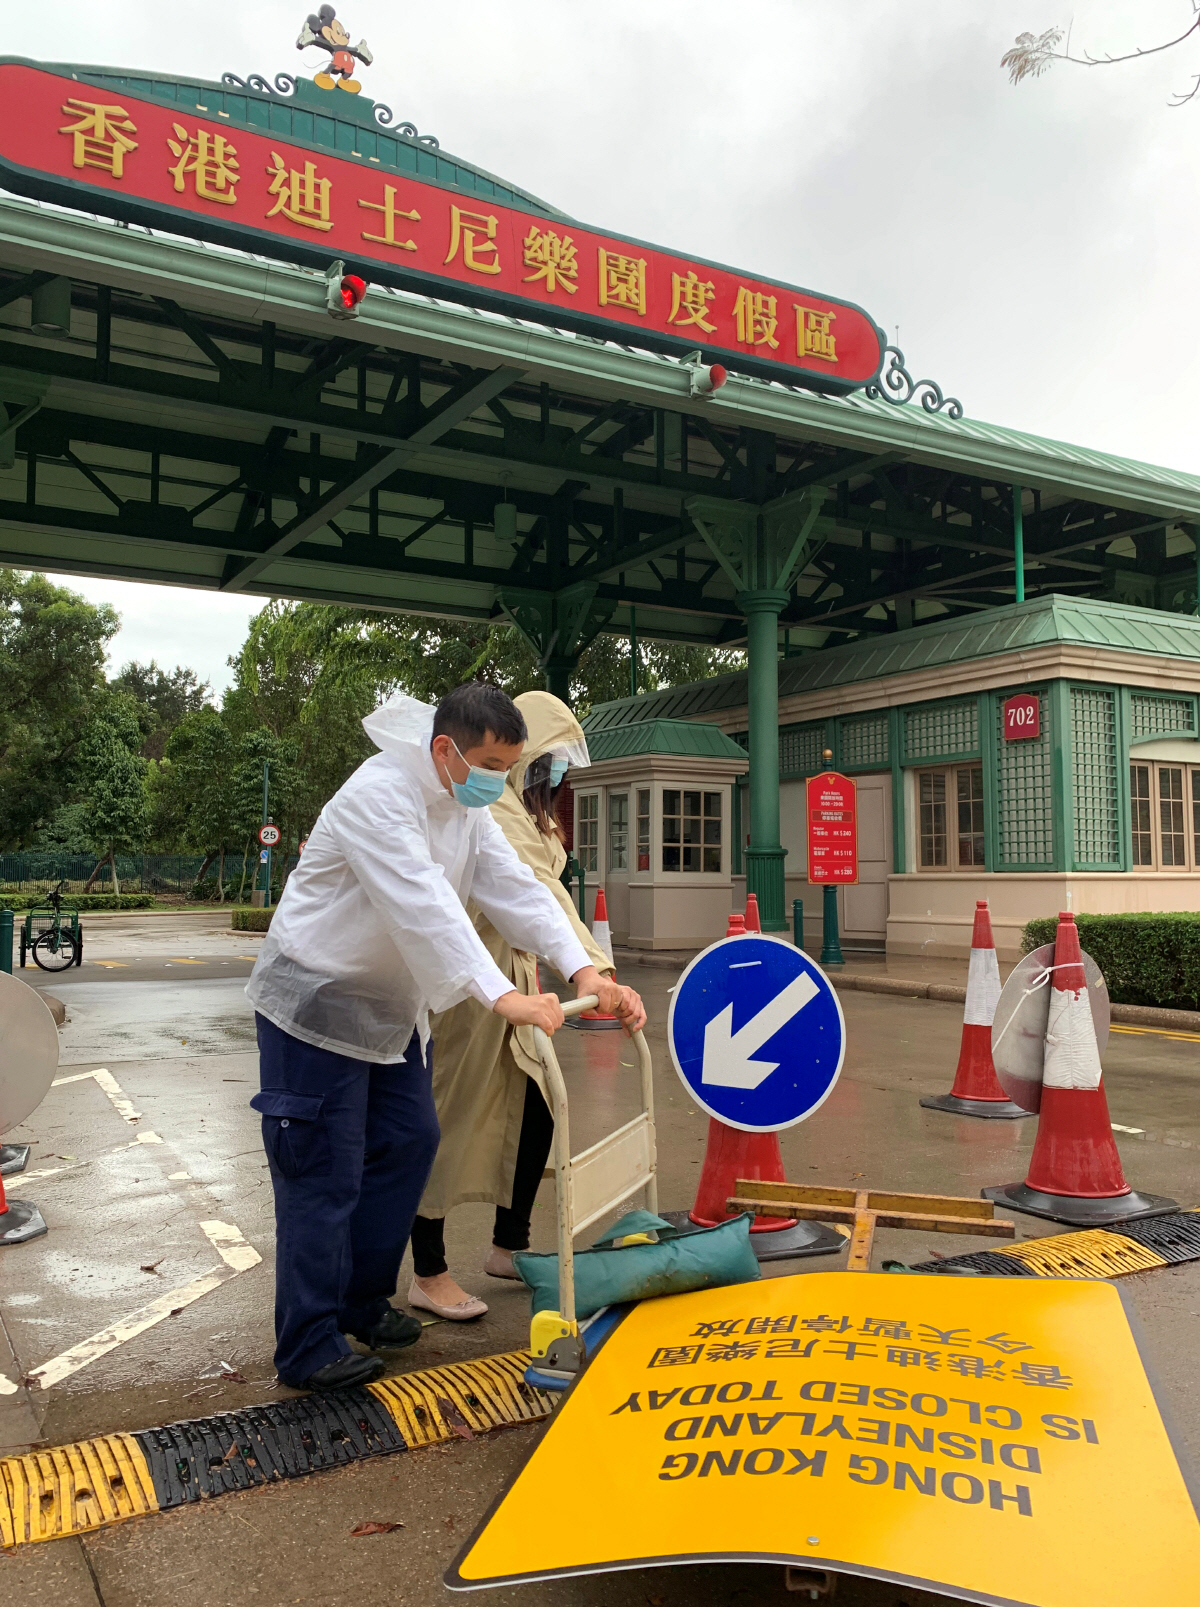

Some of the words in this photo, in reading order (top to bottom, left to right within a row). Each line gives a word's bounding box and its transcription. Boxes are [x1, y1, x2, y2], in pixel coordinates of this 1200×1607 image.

[58, 97, 838, 363] 香港迪士尼樂園度假區
[1007, 705, 1035, 727] 702
[263, 830, 277, 840] 25
[692, 1314, 1035, 1354] 今天暫停開放
[646, 1337, 1074, 1391] 香港迪士尼樂園
[609, 1380, 783, 1416] TODAY
[799, 1380, 1022, 1431] CLOSED
[664, 1411, 1042, 1474] DISNEYLAND
[1042, 1413, 1099, 1445] IS
[658, 1447, 828, 1481] KONG
[849, 1453, 1033, 1517] HONG
